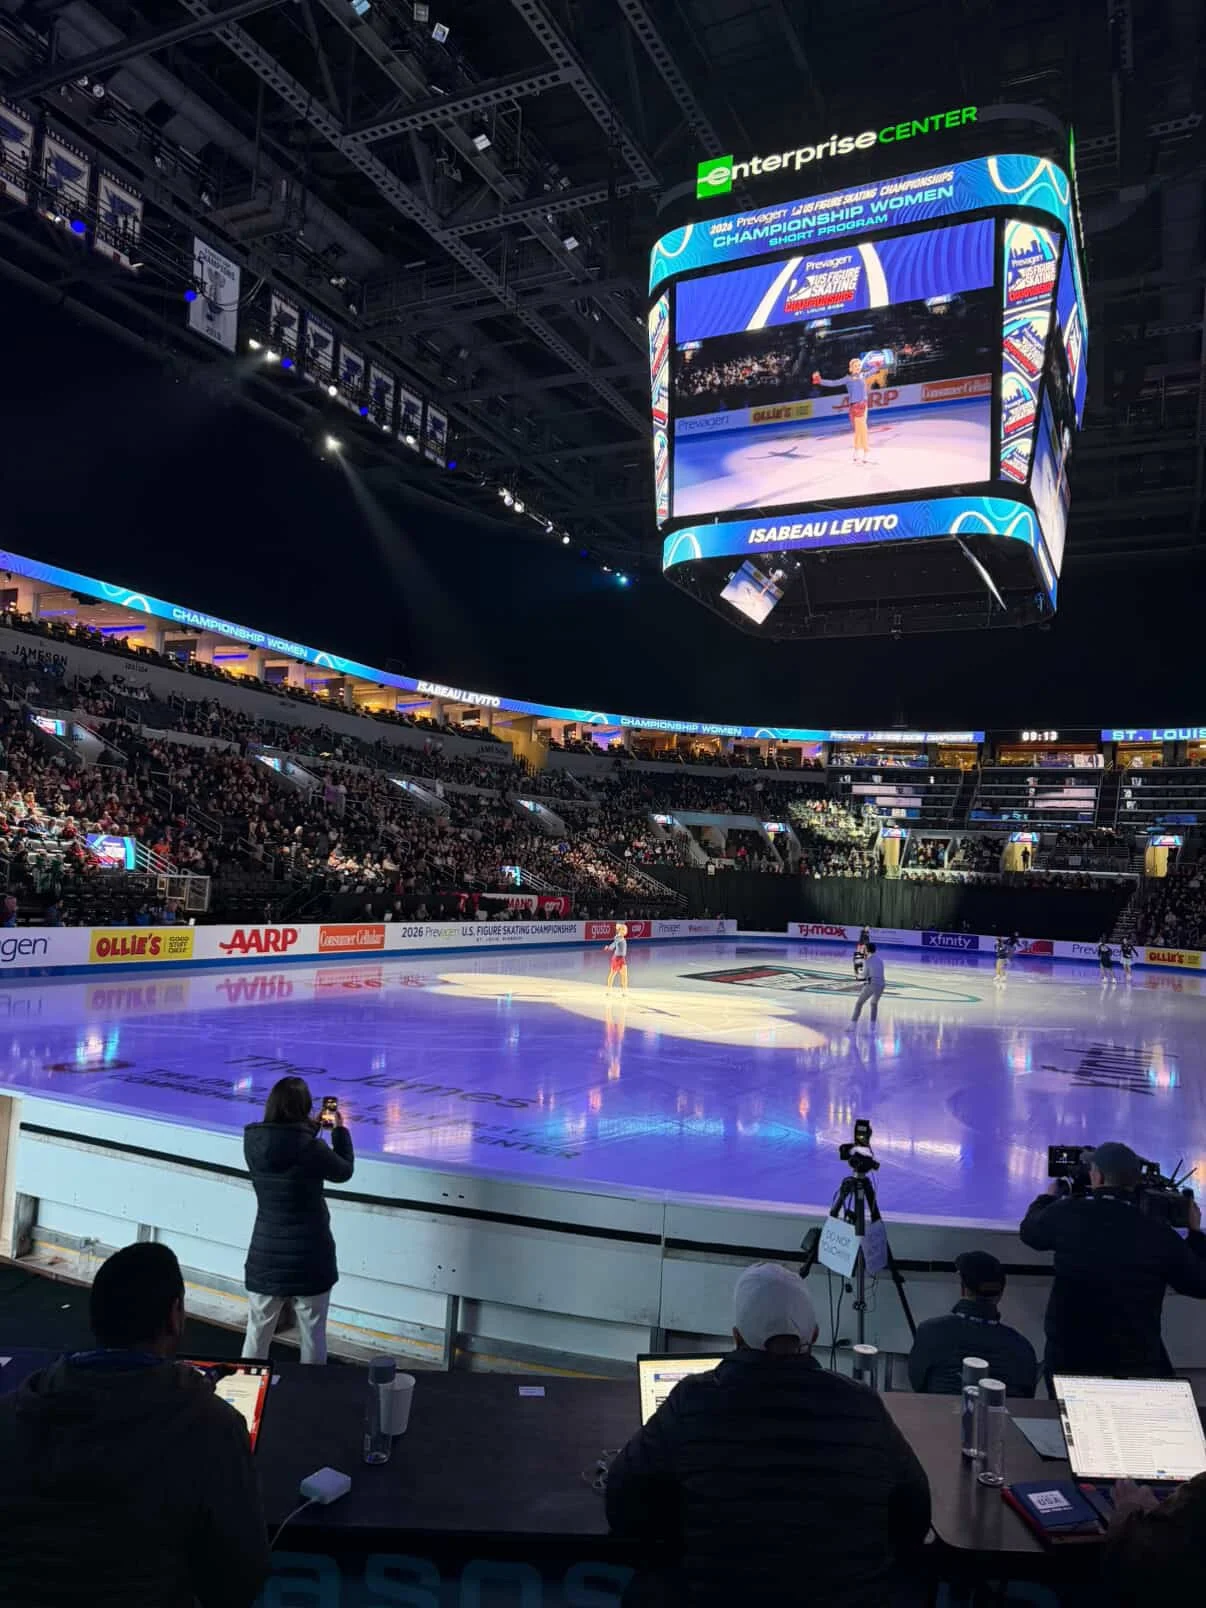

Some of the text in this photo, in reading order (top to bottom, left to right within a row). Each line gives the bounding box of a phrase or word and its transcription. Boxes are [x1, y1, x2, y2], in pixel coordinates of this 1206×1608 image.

[698, 106, 978, 185] enterprise CENTER
[880, 171, 955, 196] CHAMPIONSHIPS
[712, 186, 954, 248] CHAMPIONSHIP WOMEN
[768, 214, 888, 247] SHORT PROGRAM
[806, 255, 853, 271] Prevagen
[811, 279, 857, 297] SKATING
[748, 513, 898, 544] ISABEAU LEVITO
[172, 607, 308, 657] CHAMPIONSHIP WOMEN
[417, 680, 501, 707] ISABEAU LEVITO
[620, 717, 742, 736] CHAMPIONSHIP WOMEN
[1112, 730, 1143, 741] ST.
[219, 927, 299, 954] AARP
[401, 927, 424, 938] 2026
[476, 926, 501, 937] FIGURE
[502, 925, 530, 936] SKATING
[530, 924, 577, 935] CHAMPIONSHIPS
[928, 935, 974, 949] xfinity
[96, 932, 161, 957] OLLIE'S
[1148, 951, 1185, 964] OLLIE'S
[225, 1054, 539, 1108] The James
